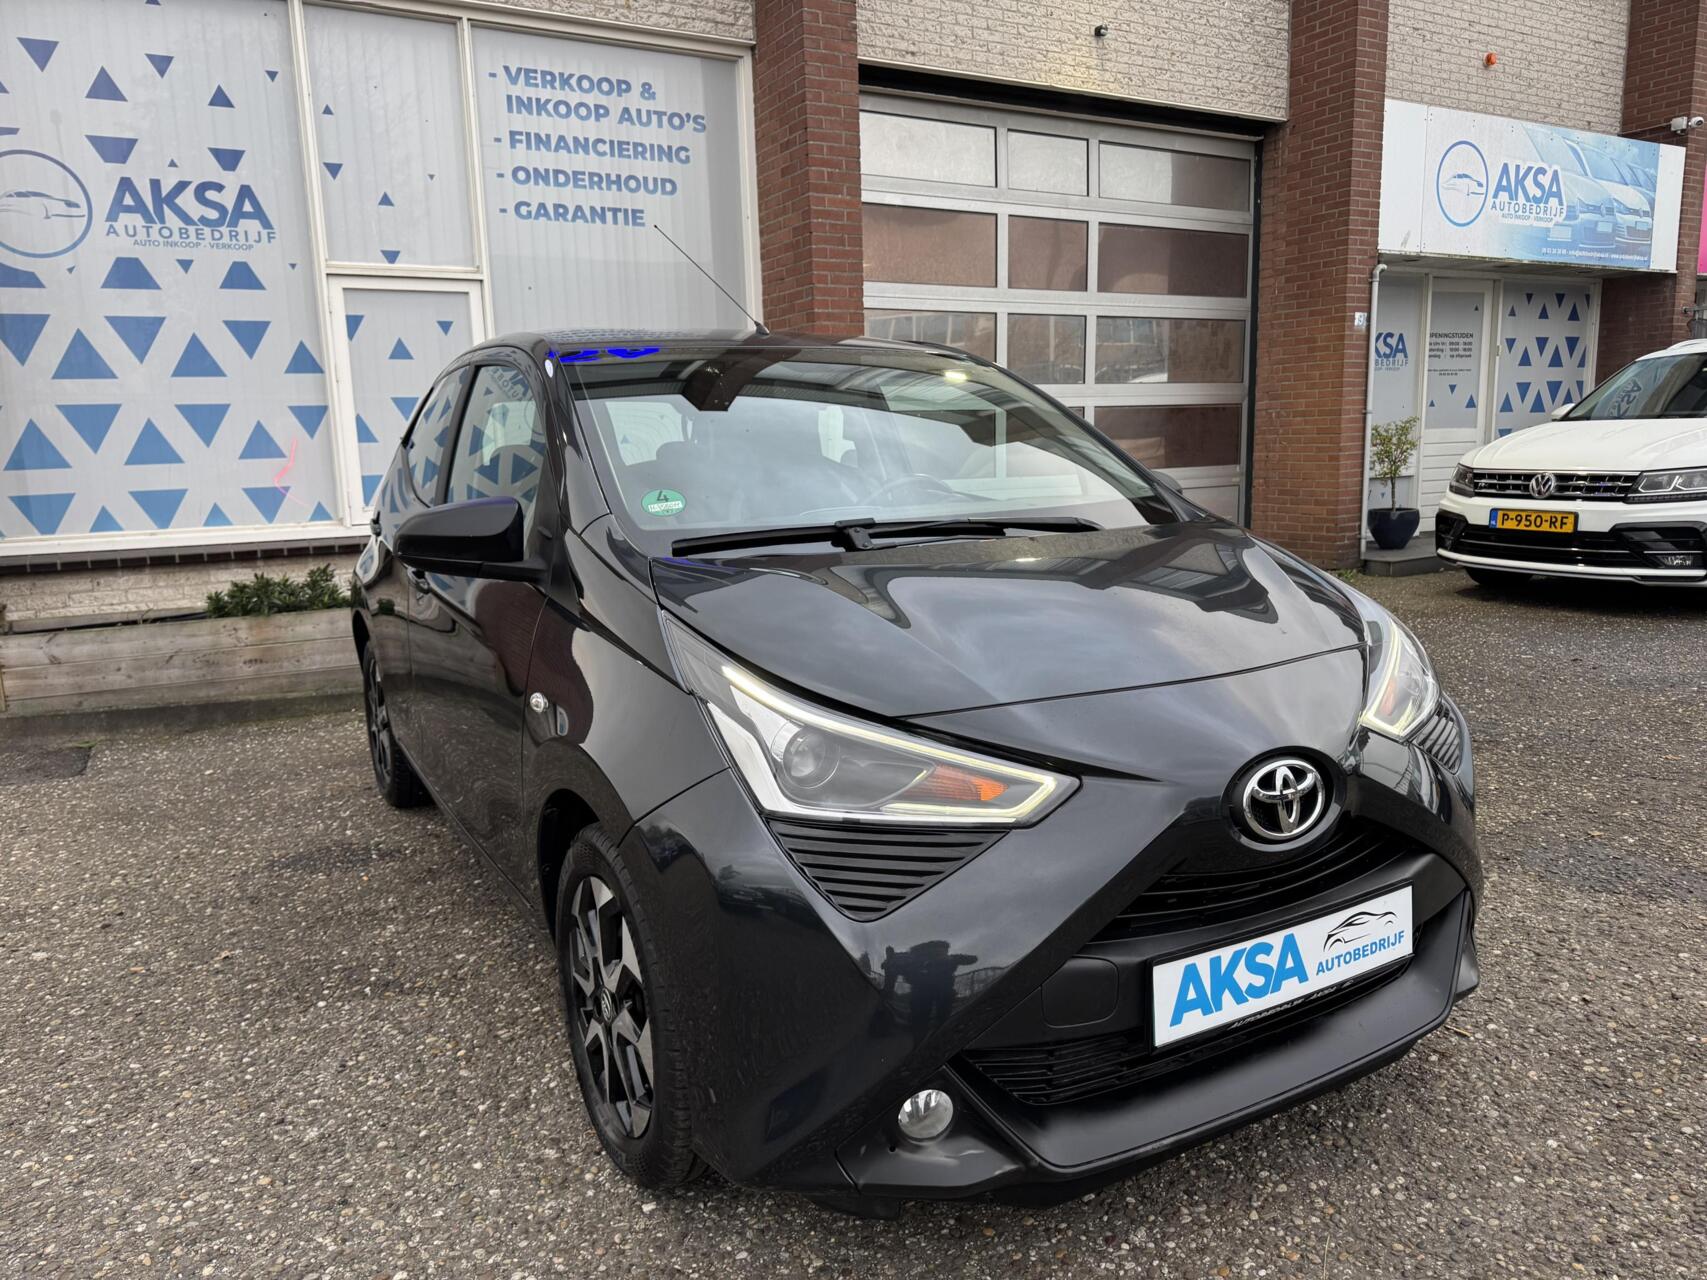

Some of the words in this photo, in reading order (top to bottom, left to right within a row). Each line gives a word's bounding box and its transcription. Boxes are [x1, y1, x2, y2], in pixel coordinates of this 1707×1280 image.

[503, 65, 631, 97] VERKOOP
[640, 82, 656, 100] &
[506, 94, 610, 122] INKOOP
[618, 106, 706, 133] AUTO'S
[508, 130, 690, 164] FINANCIERING
[511, 165, 677, 196] ONDERHOUD
[1492, 162, 1564, 206] AKSA
[105, 176, 274, 230] AKSA
[514, 200, 646, 227] GARANTIE
[1491, 200, 1564, 217] AUTOBEDRIJF
[105, 223, 276, 244] AUTOBEDRIJF
[133, 239, 160, 247] AUTO
[163, 240, 201, 249] INKOOP
[209, 242, 254, 251] VERKOOP
[1501, 512, 1569, 530] P-950-RF
[1316, 930, 1405, 976] AUTOBEDRIJF
[1169, 932, 1309, 1028] AKSA
